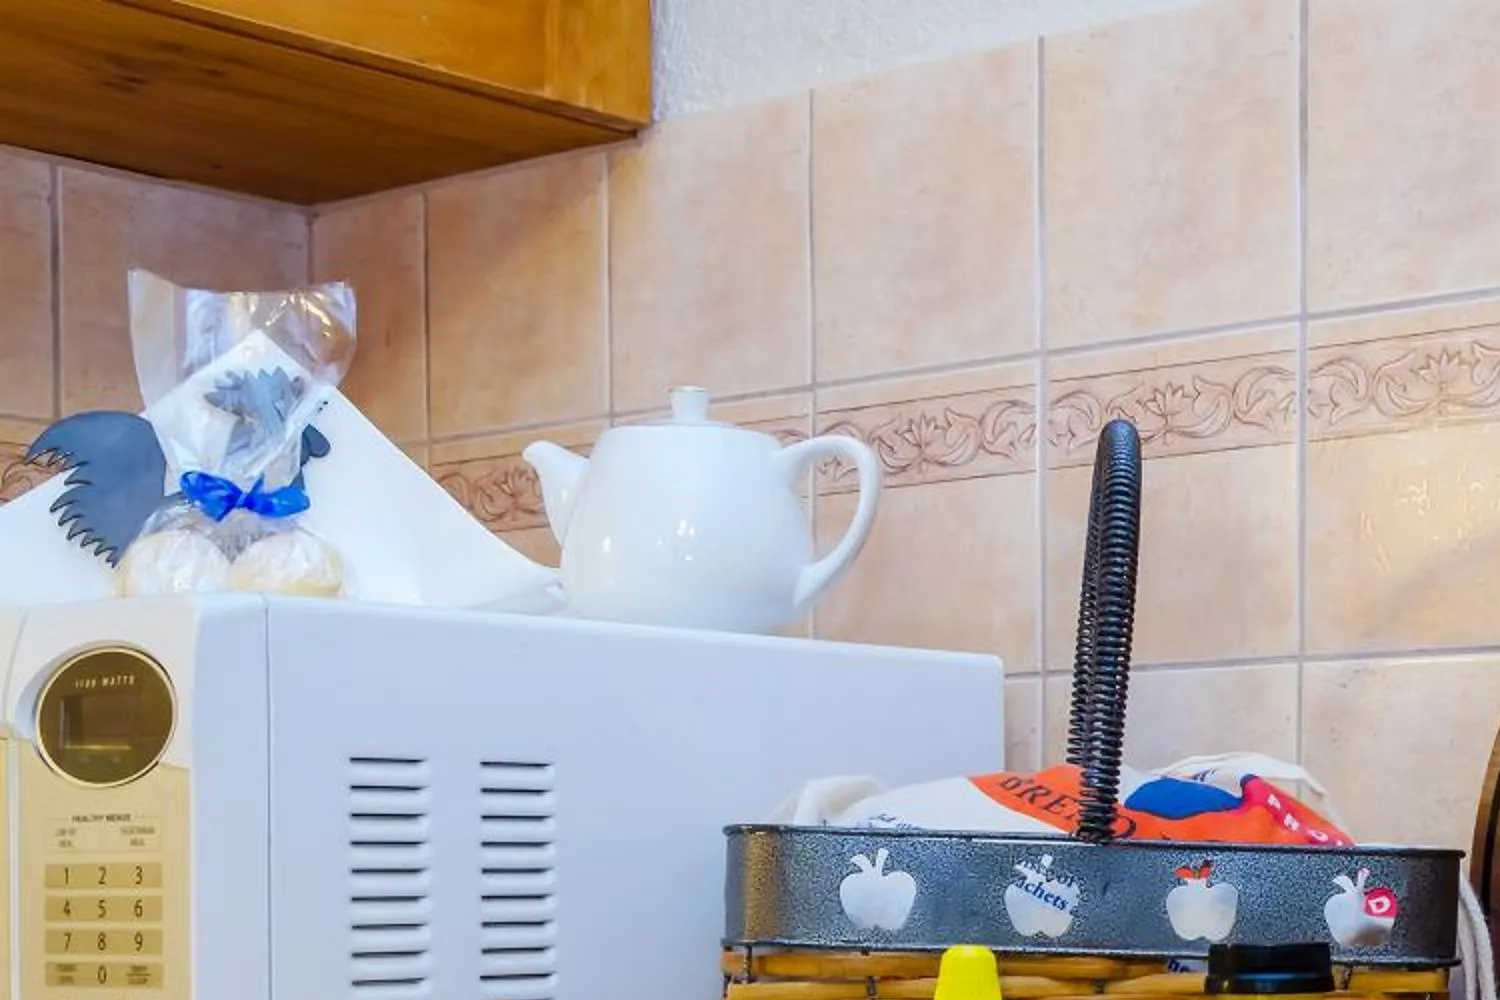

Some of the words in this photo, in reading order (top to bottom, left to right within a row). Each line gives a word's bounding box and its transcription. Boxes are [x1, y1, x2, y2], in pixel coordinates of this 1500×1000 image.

[64, 867, 69, 885] 1
[97, 867, 107, 885] 2
[135, 865, 143, 885] 3
[63, 901, 71, 918] 4
[97, 899, 107, 919] 5
[134, 900, 143, 918] 6
[64, 932, 72, 950] 7
[97, 931, 107, 951] 8
[134, 931, 143, 951] 9
[97, 965, 107, 985] 0
